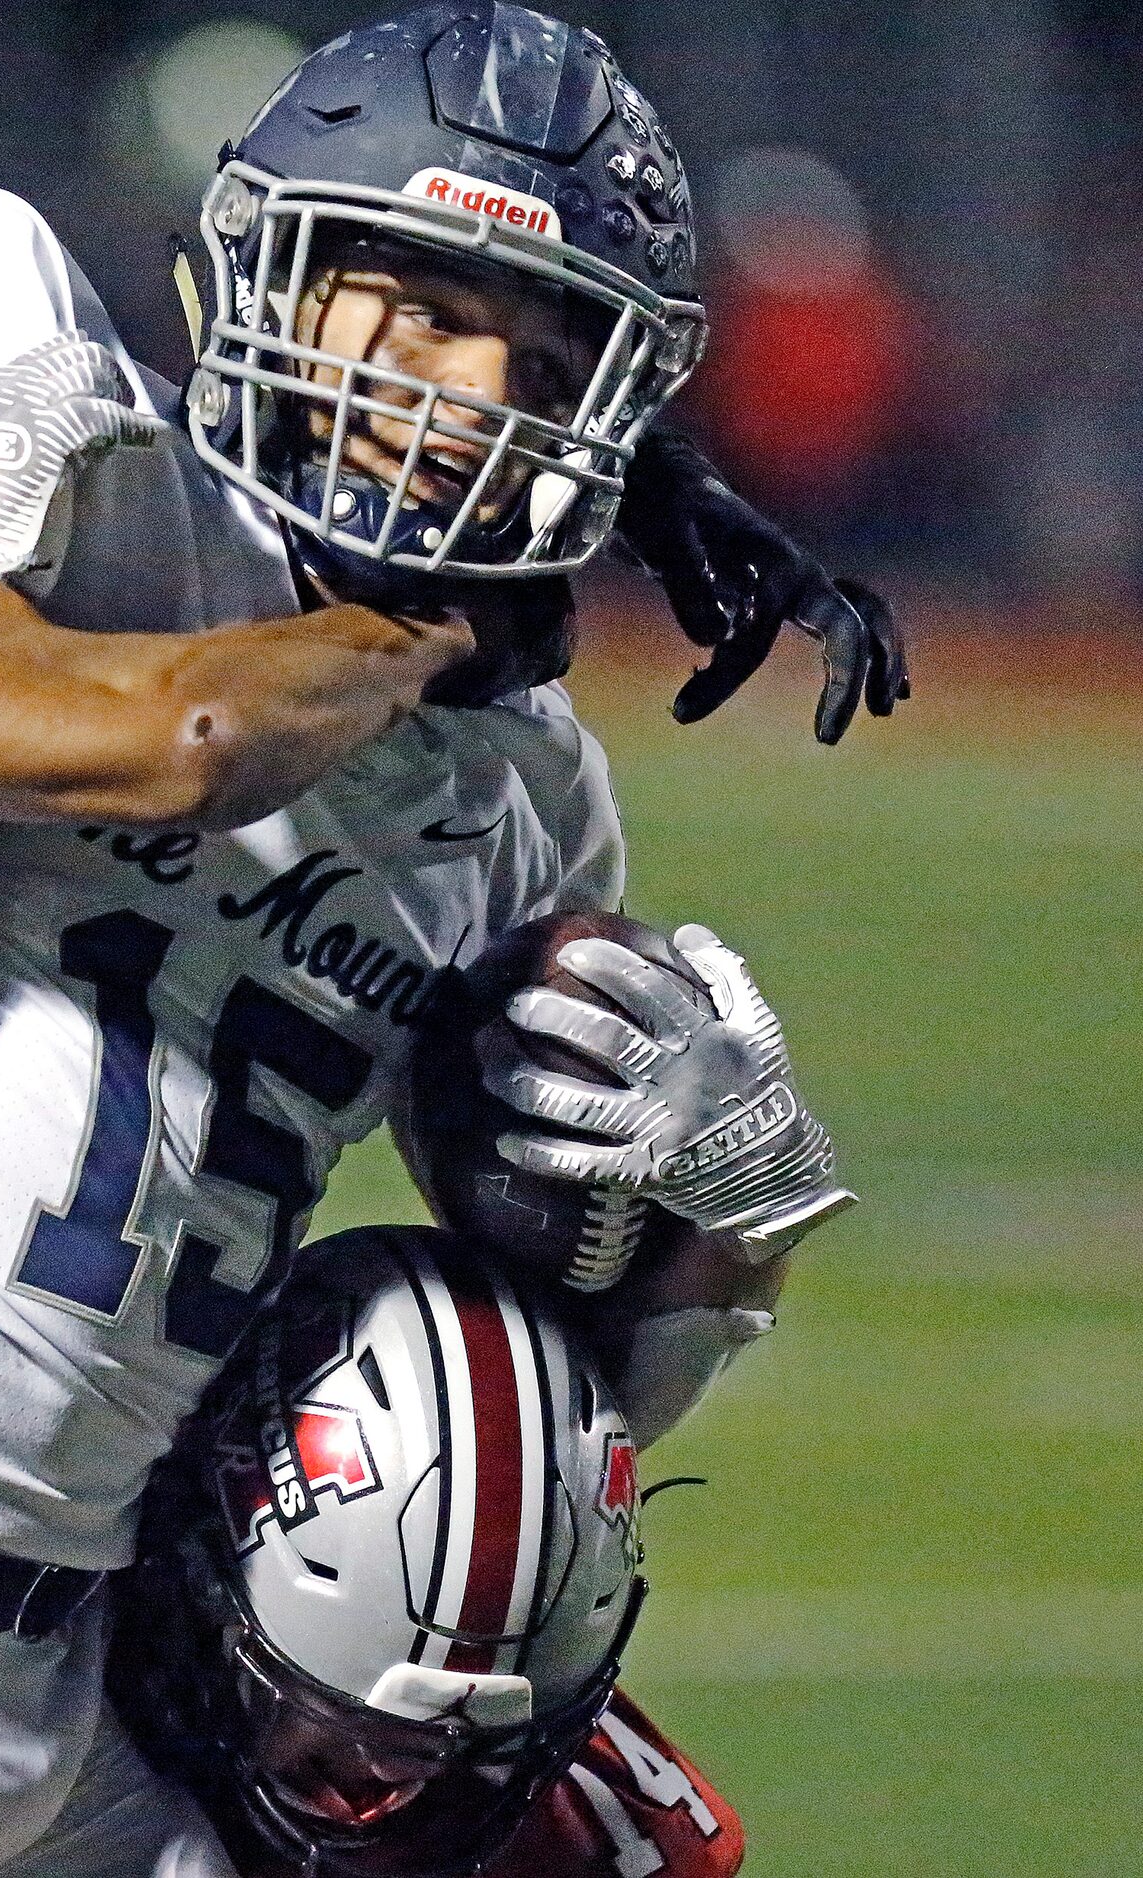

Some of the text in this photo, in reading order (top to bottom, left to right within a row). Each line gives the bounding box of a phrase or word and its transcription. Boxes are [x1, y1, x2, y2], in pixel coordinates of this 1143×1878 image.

[425, 177, 549, 233] Riddell
[218, 849, 472, 1026] Moun
[6, 908, 374, 1360] 15
[667, 1096, 786, 1177] BATTLE
[568, 1711, 719, 1877] 14
